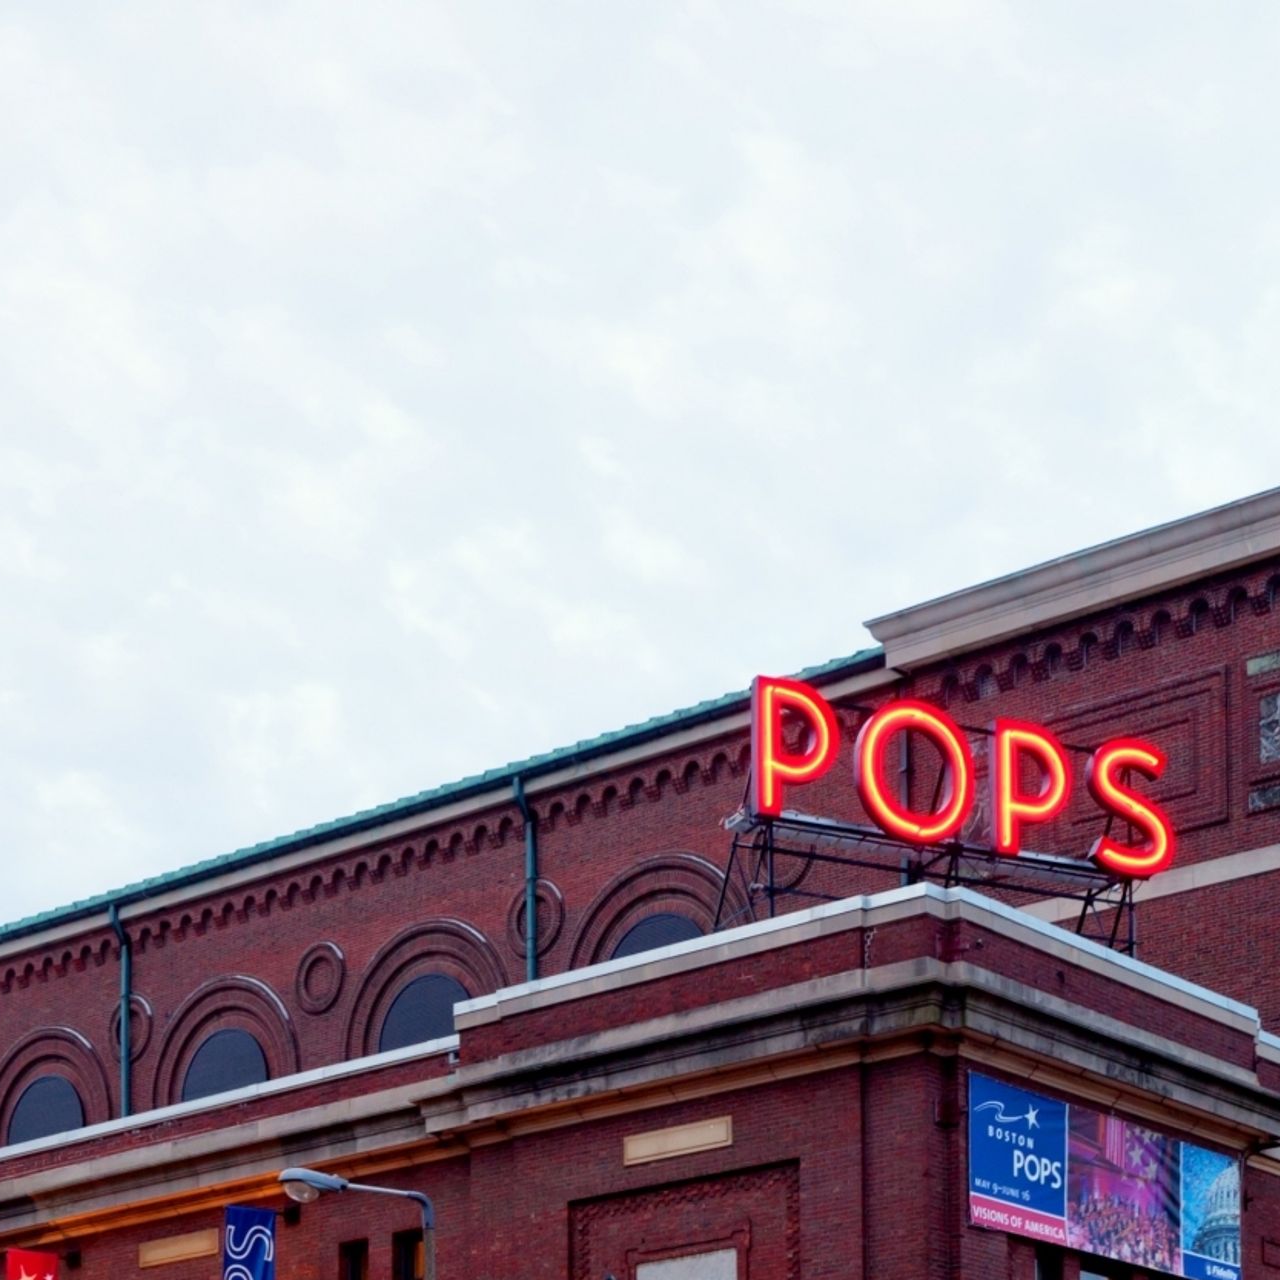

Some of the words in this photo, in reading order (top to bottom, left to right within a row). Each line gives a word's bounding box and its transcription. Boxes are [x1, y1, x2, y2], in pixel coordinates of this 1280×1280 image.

[751, 674, 1175, 881] POPS
[987, 1125, 1034, 1149] BOSTON
[974, 1177, 991, 1189] MAY
[1013, 1149, 1062, 1189] POPS
[972, 1205, 1009, 1226] VISIONS
[1010, 1215, 1023, 1228] OF
[1024, 1220, 1065, 1240] AMERICA
